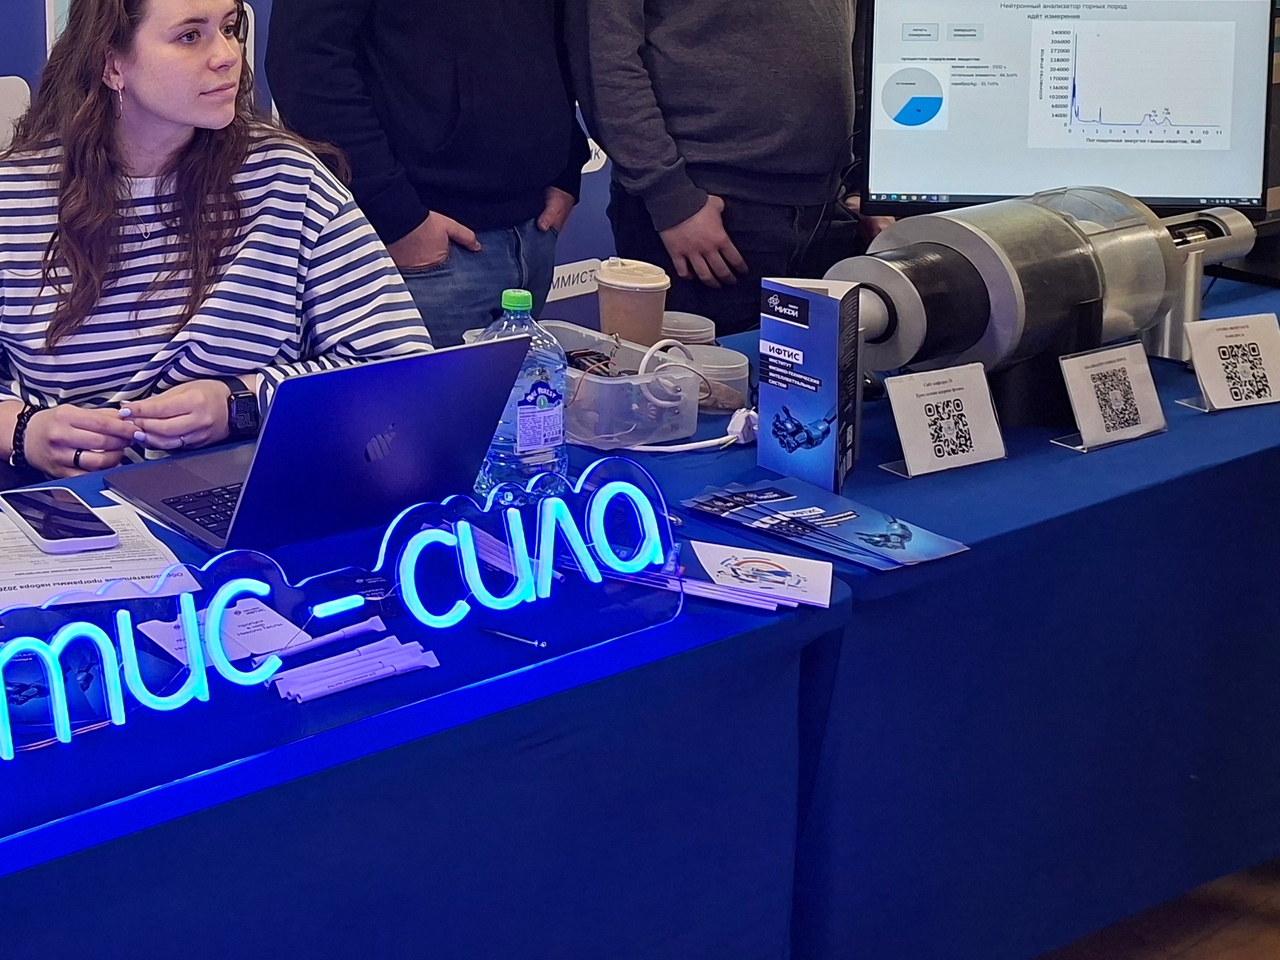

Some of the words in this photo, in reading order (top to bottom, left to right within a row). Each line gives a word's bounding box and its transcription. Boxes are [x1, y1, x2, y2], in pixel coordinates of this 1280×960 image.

[1000, 2, 1041, 10] Нейтронный
[1043, 2, 1081, 10] анализатор
[774, 305, 798, 318] МИФИ
[768, 345, 800, 361] ИФТИС
[398, 479, 668, 628] сила
[19, 581, 52, 591] набора
[53, 577, 104, 589] программы
